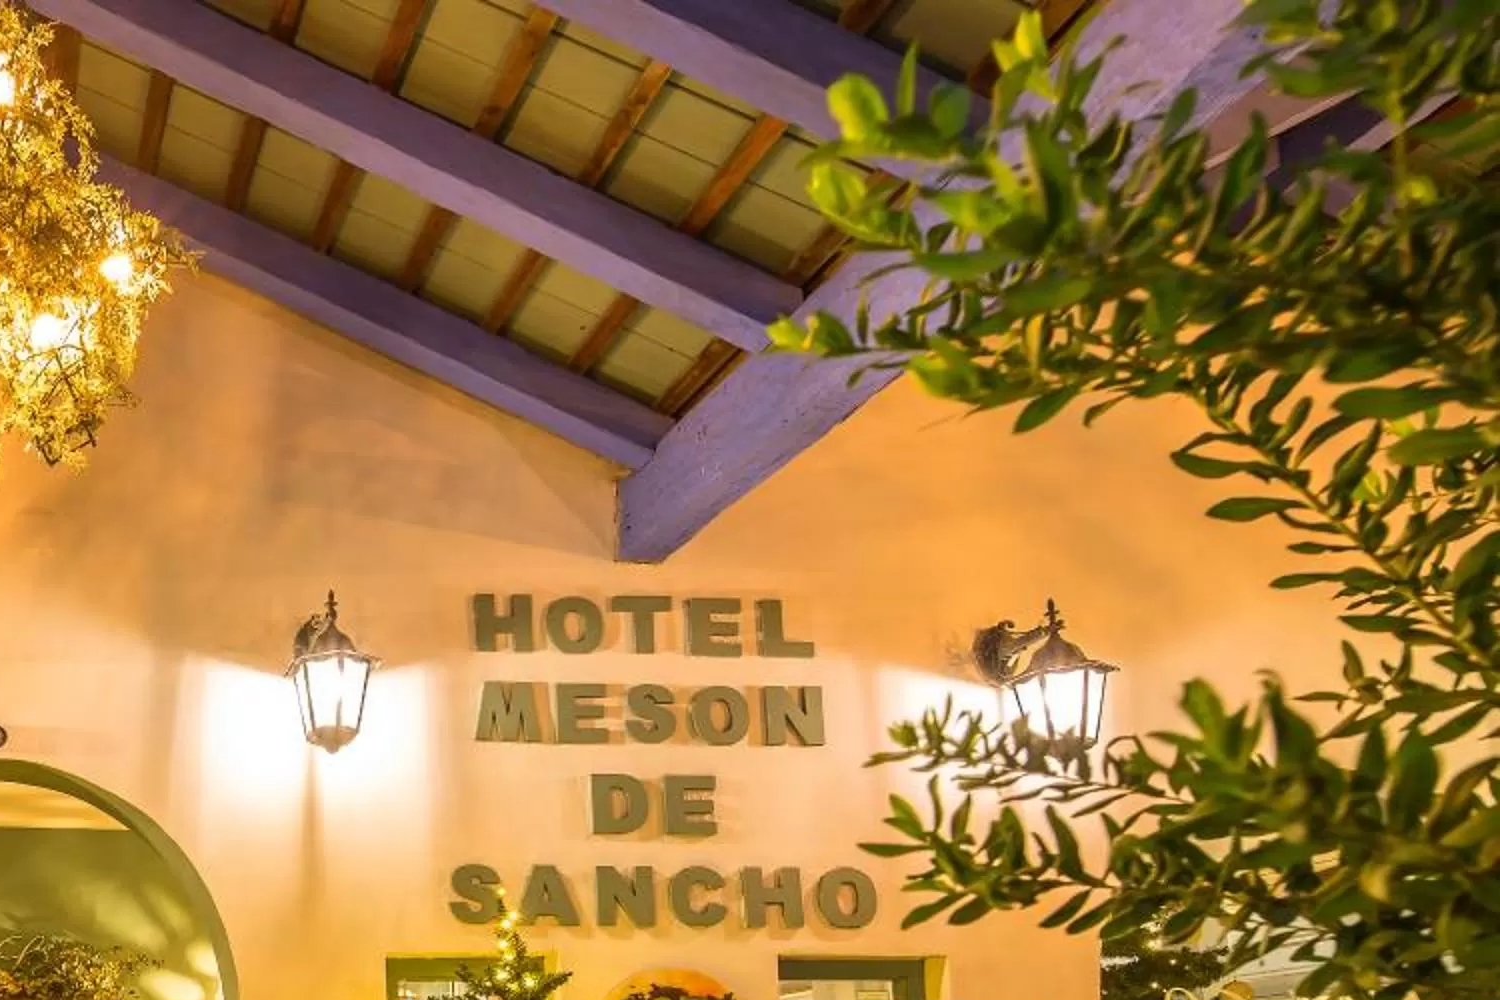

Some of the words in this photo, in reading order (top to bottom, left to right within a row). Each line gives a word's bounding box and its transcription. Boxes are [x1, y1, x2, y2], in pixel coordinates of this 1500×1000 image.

[473, 593, 815, 658] HOTEL
[474, 680, 826, 747] MESON
[589, 773, 719, 837] DE
[448, 864, 878, 930] SANCHO
